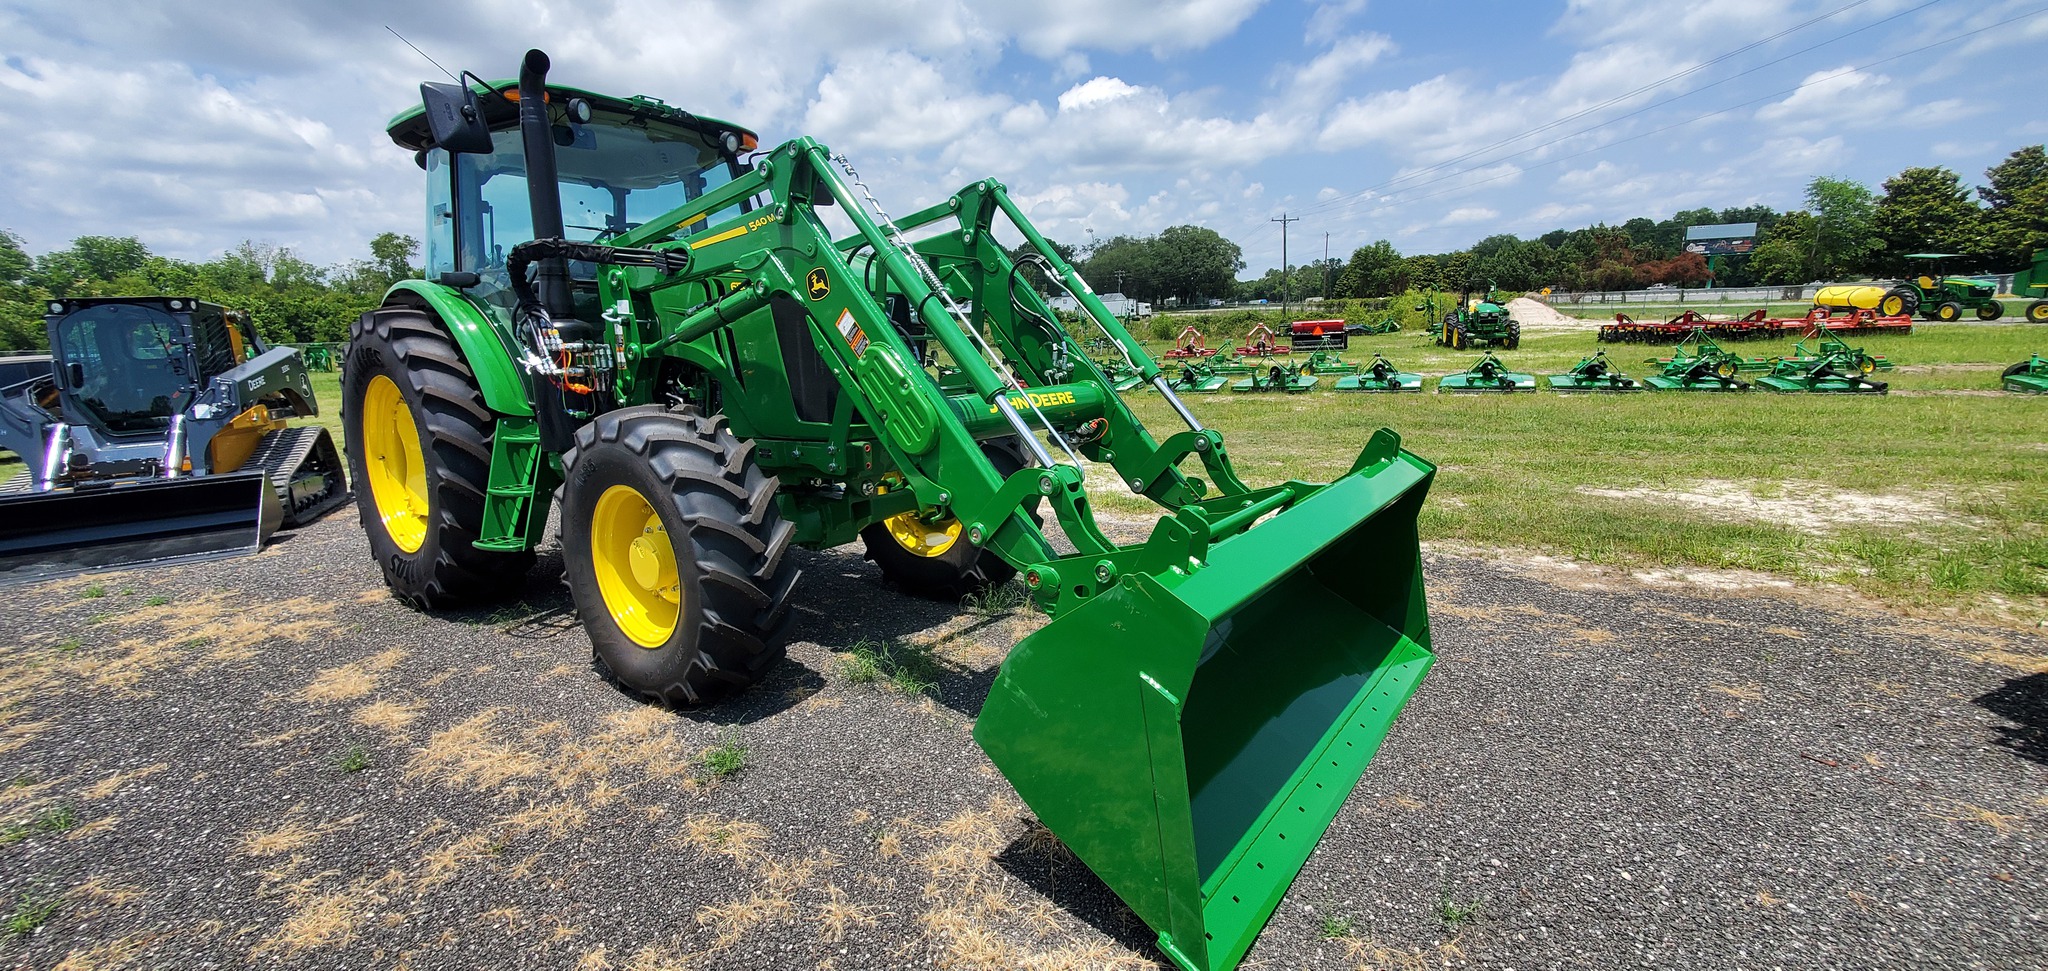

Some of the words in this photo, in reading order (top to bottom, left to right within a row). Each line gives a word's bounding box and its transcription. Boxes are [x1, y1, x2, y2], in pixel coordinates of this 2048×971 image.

[748, 216, 768, 232] 540
[766, 213, 777, 223] M
[247, 375, 267, 392] DEERE
[989, 397, 1030, 414] JHN
[1027, 391, 1076, 408] DEERE
